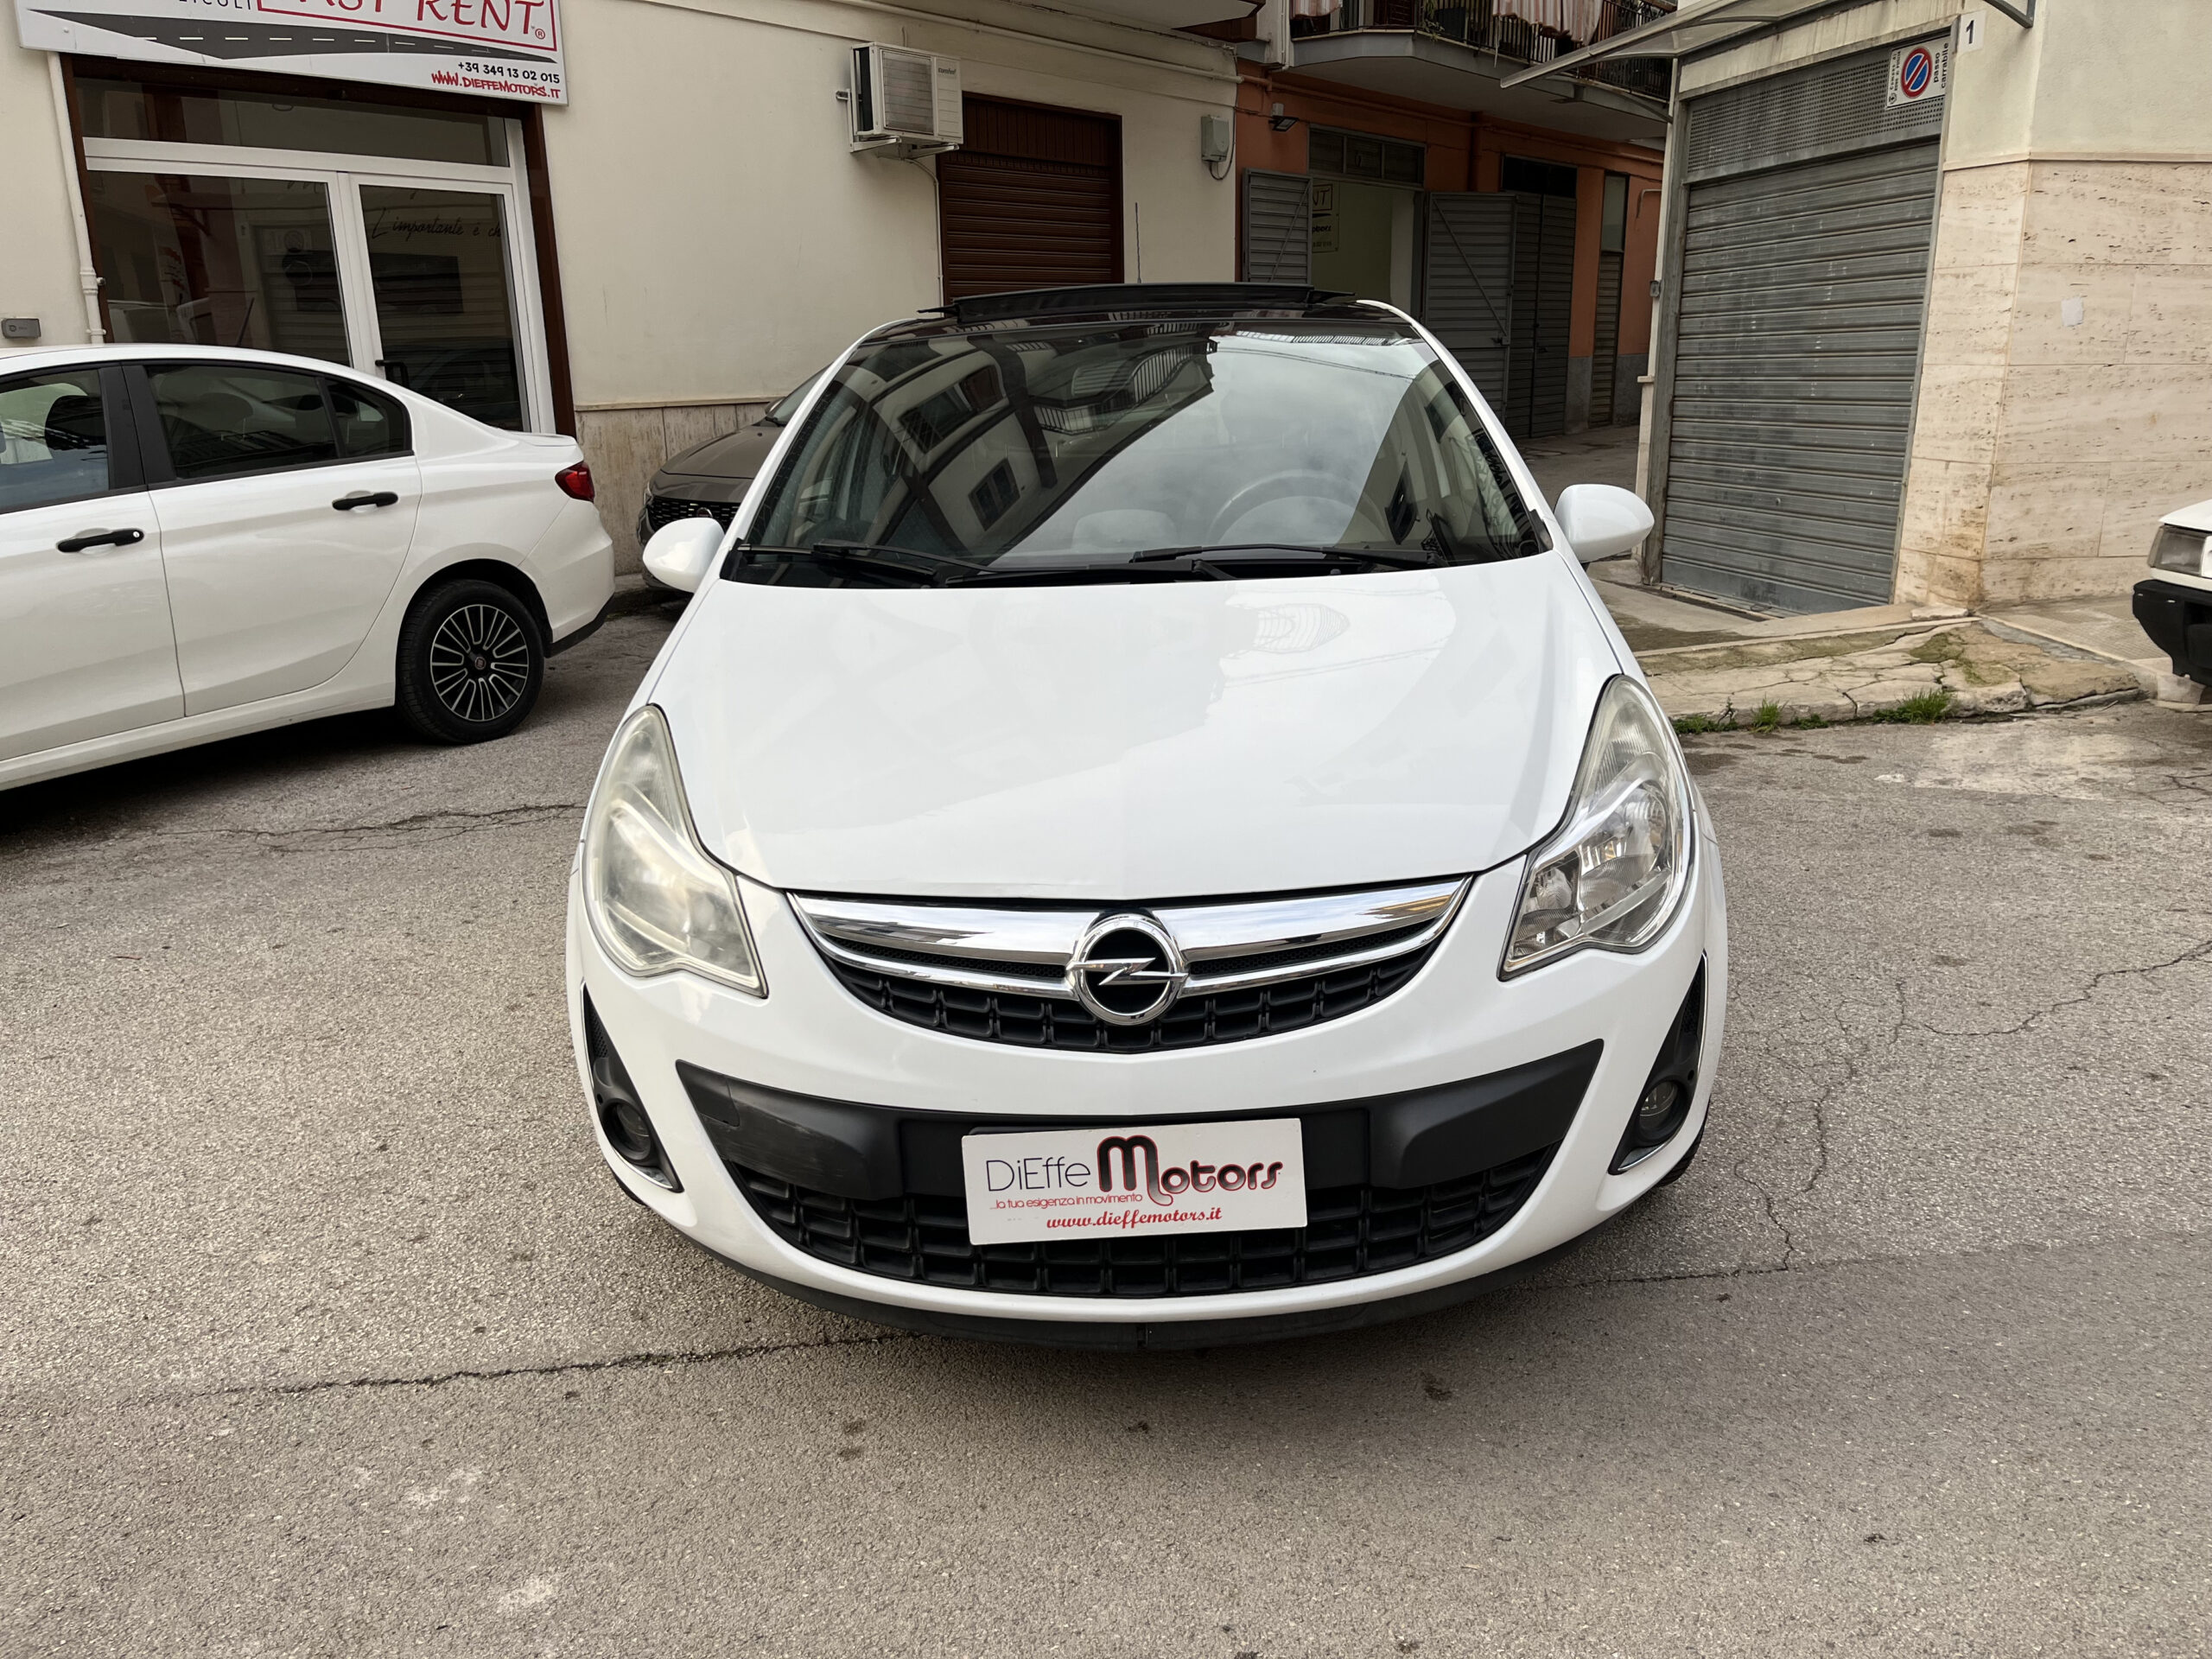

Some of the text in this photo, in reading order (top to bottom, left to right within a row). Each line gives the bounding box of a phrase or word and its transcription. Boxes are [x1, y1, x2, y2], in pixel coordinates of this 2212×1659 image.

[417, 0, 544, 35] RENT
[1966, 20, 1974, 44] 1
[431, 70, 561, 99] WWW.DIEFFEMOTORS.IT
[458, 61, 560, 84] +39 349 13 02 015
[986, 1156, 1090, 1192] DiEffe
[1007, 1197, 1025, 1208] tua
[1027, 1195, 1076, 1210] esigenza
[1076, 1195, 1085, 1205] in
[1085, 1192, 1143, 1205] movimento
[1046, 1207, 1222, 1229] www.dieffemotors.it
